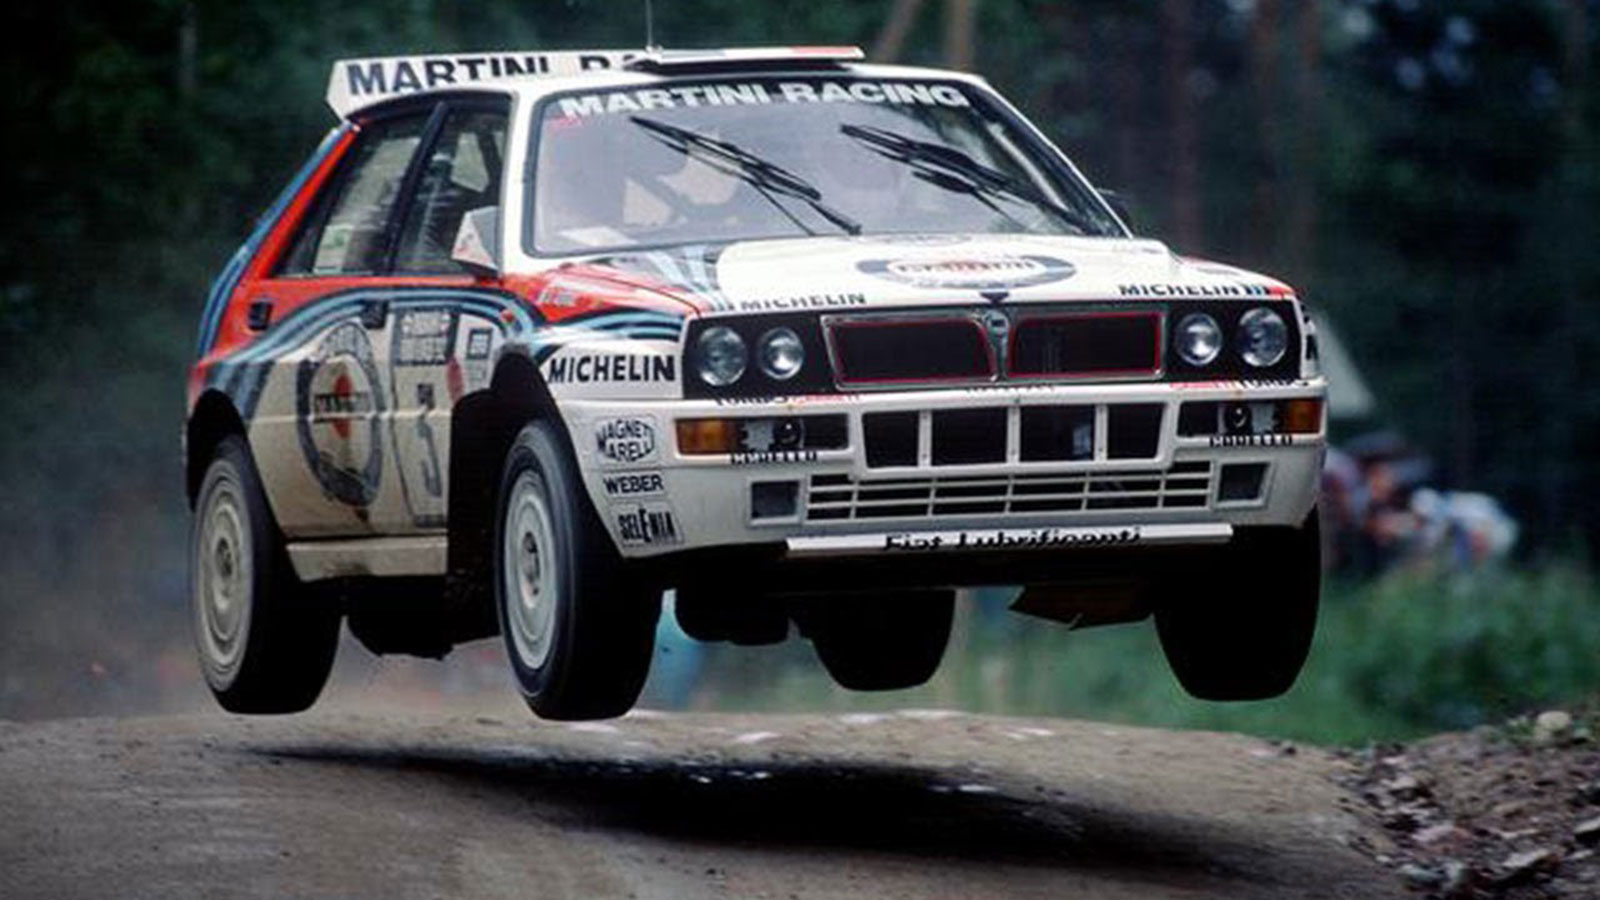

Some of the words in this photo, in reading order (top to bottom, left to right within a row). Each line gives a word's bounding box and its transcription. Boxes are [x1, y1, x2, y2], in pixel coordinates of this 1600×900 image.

[346, 56, 550, 95] MARTINI
[559, 84, 767, 117] MARTINI
[780, 81, 969, 107] RACING
[740, 293, 867, 311] MICHELIN
[1117, 283, 1240, 297] MICHELIN
[549, 354, 676, 383] MICHELIN
[603, 474, 664, 494] WEBER
[618, 508, 677, 543] SELENIA
[884, 533, 944, 550] Fiat
